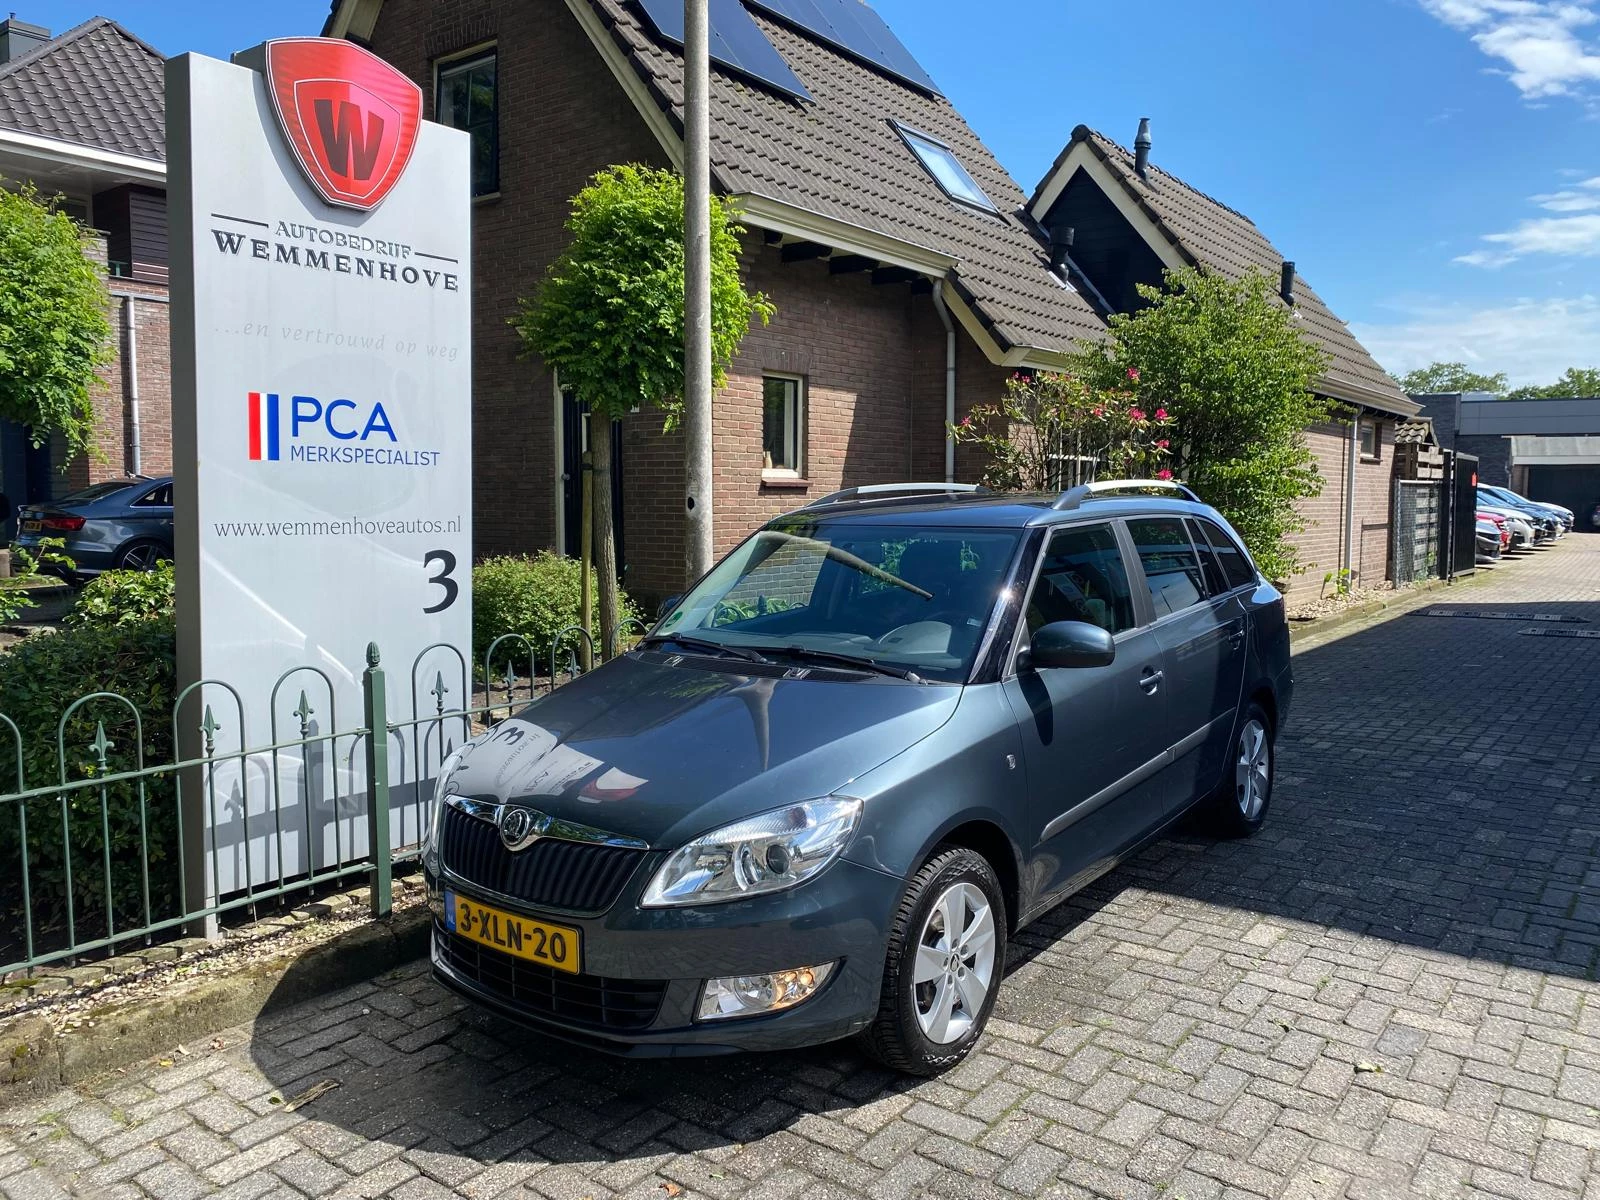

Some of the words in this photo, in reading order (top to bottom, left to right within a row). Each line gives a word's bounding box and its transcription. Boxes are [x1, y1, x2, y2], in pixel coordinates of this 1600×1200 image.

[313, 98, 385, 181] W
[210, 228, 459, 292] WEMMENHOVE
[275, 220, 412, 259] AUTOBEDRIJF
[281, 326, 385, 352] vertrouwd
[395, 340, 417, 354] op
[426, 345, 459, 363] weg
[291, 395, 398, 442] PCA
[290, 445, 441, 466] MERKSPECIALIST
[214, 516, 462, 537] www.wemmenhoveautos.nl
[422, 549, 460, 614] 3
[460, 903, 567, 963] 3-XLN-20
